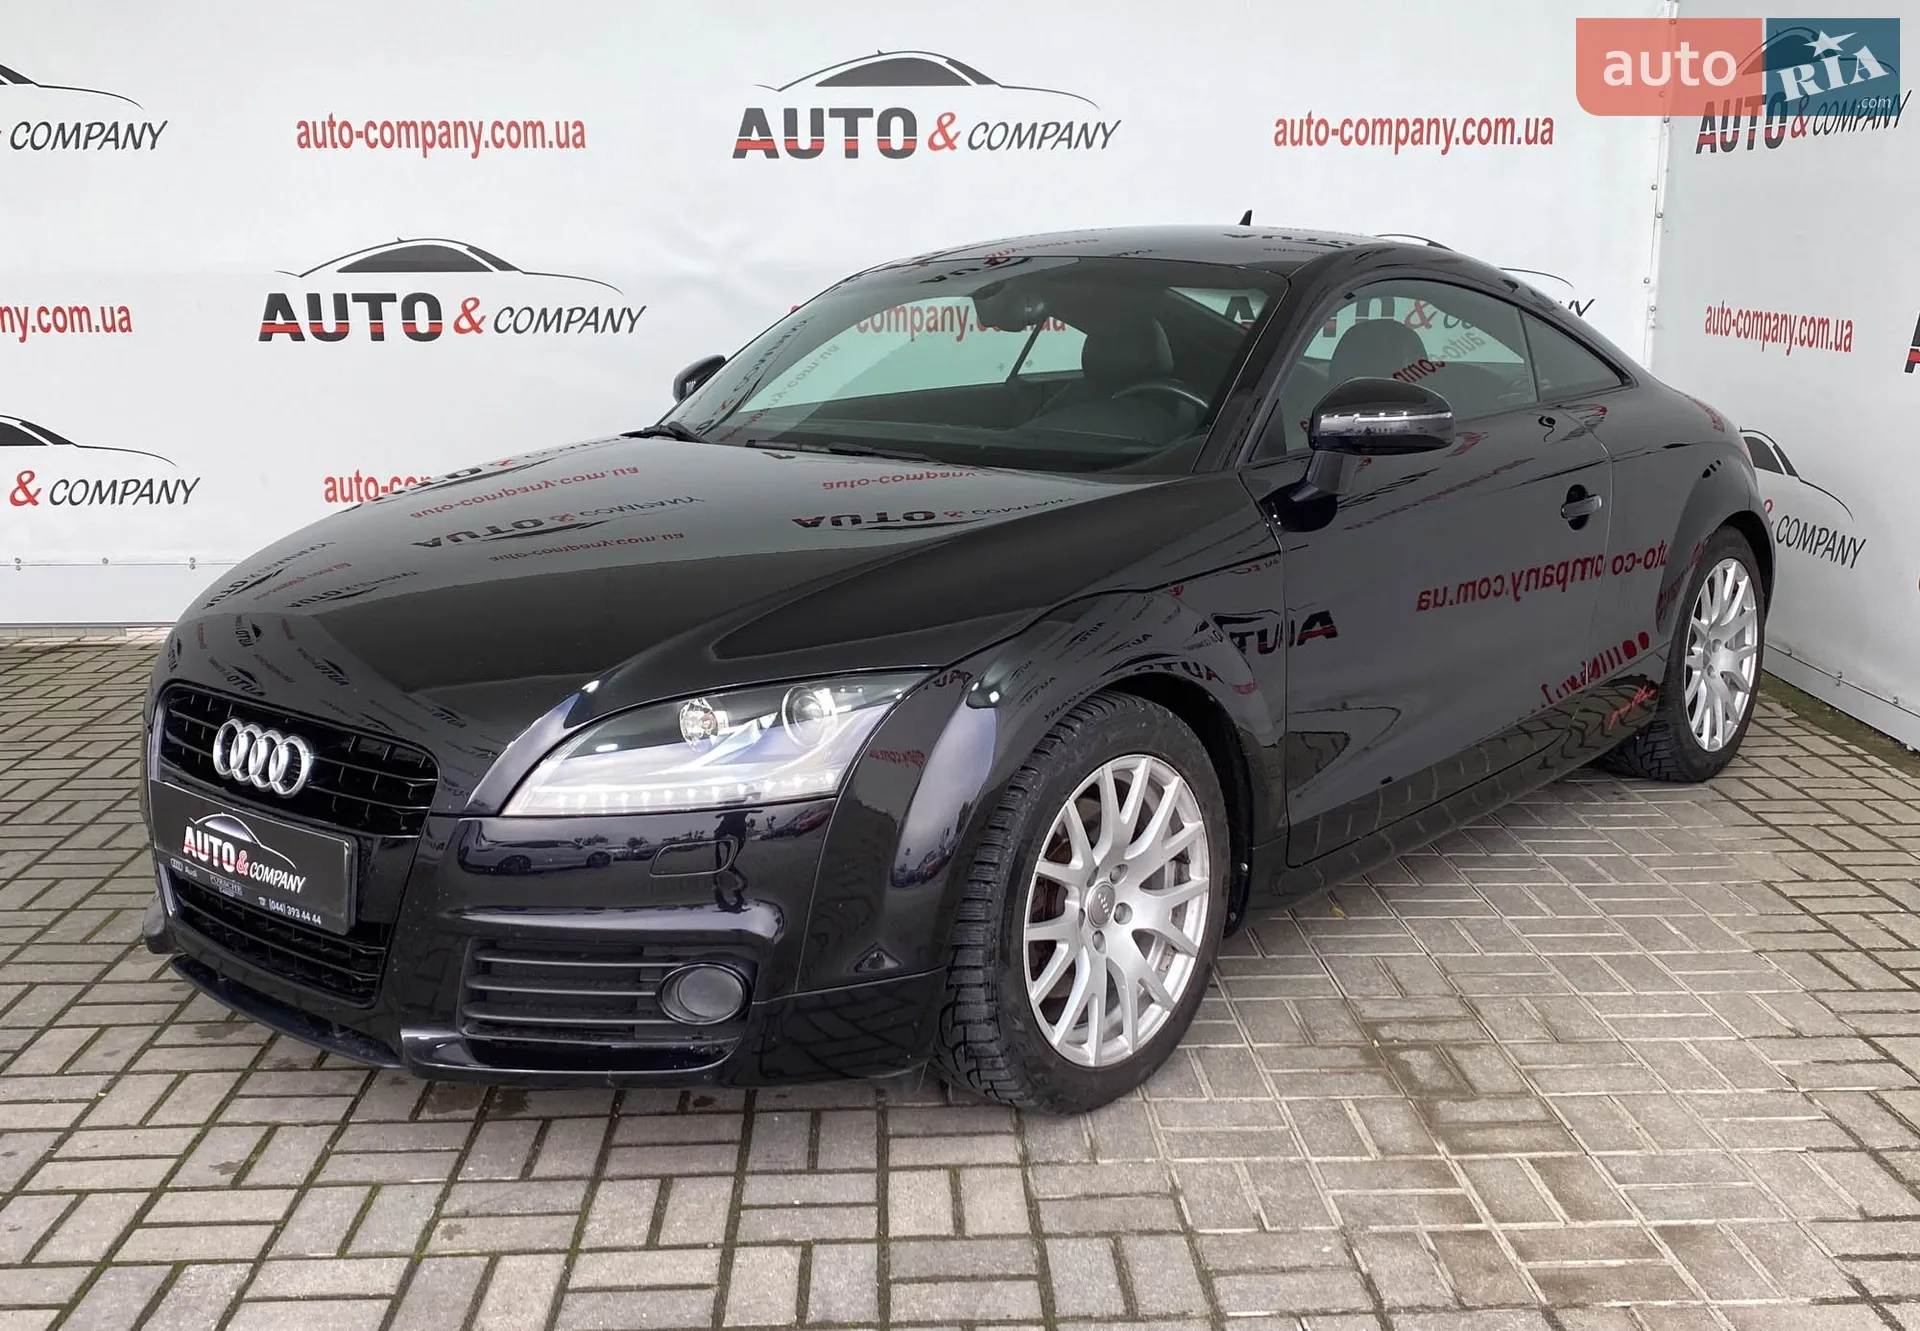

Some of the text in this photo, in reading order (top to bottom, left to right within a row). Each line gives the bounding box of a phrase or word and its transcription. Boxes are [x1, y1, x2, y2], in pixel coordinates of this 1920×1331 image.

[10, 119, 169, 151] COMPANY
[296, 112, 586, 159] auto-company.com.ua
[732, 107, 1122, 159] AUTO & COMPANY
[1274, 111, 1554, 155] auto-company.com.ua
[1695, 89, 1912, 155] AUTO & COMPANY
[258, 292, 648, 342] AUTO & COMPANY
[1704, 300, 1853, 356] auto-company.com.ua
[9, 470, 201, 507] & COMPANY
[1775, 514, 1867, 570] COMPANY
[183, 825, 307, 894] AUTO & COMPANY
[268, 898, 322, 927] (044) 393 44 44
